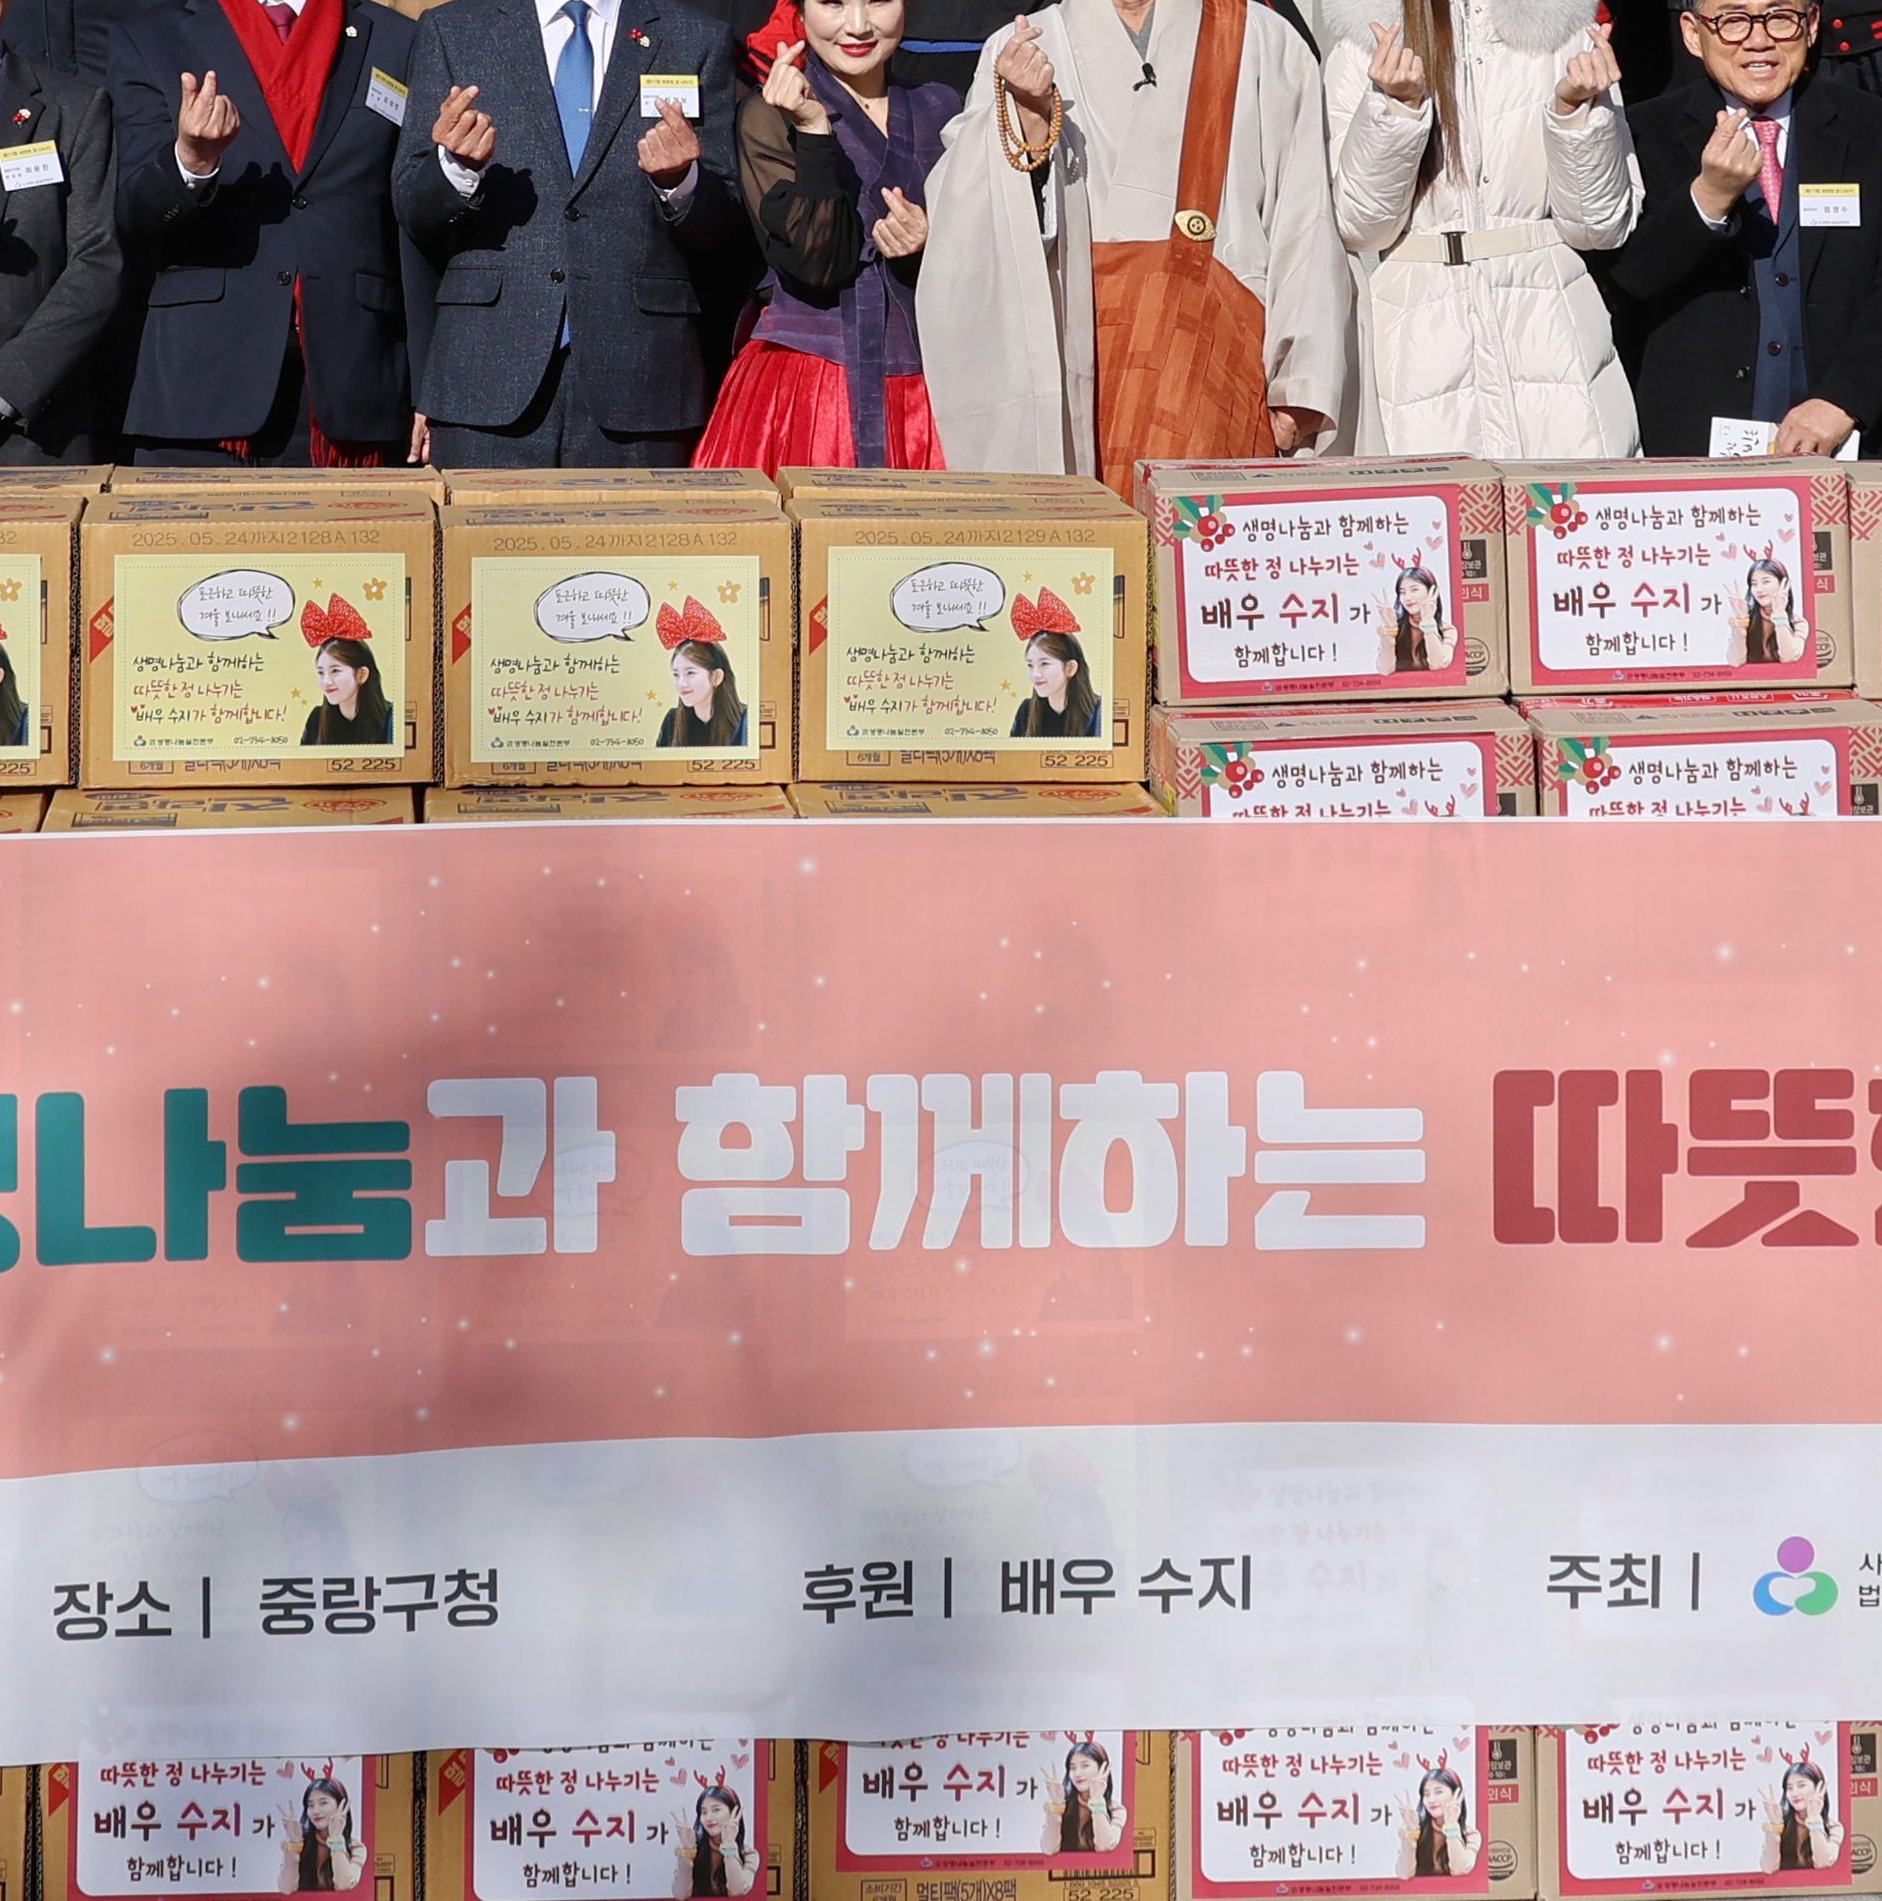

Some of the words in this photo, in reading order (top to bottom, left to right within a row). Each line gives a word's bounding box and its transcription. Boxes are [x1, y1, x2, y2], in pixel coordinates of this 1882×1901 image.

[1596, 505, 1683, 530] 생명나눔과
[1691, 504, 1761, 528] 함께하는
[1557, 546, 1611, 569] 따뜻한
[1617, 544, 1633, 569] 정
[1642, 543, 1711, 566] 나누기는
[1553, 581, 1616, 619] 배우
[1631, 582, 1689, 618] 수지
[846, 645, 915, 664] 생명나눔과
[919, 644, 975, 664] 함께하는
[847, 670, 890, 690] 따뜻한
[893, 673, 906, 689] 정
[910, 671, 953, 690] 나누기는
[849, 700, 876, 714] 배우
[921, 695, 997, 715] 함께합니다!
[1044, 754, 1069, 768] 52
[1074, 754, 1109, 768] 225
[675, 1069, 1427, 1256] 함께하는
[802, 1559, 914, 1625] 후원
[1000, 1558, 1116, 1616] 배우
[1138, 1554, 1251, 1615] 수지
[1546, 1552, 1661, 1610] 주최
[53, 1580, 173, 1641] 장소
[259, 1568, 499, 1636] 중랑구청
[101, 1762, 159, 1787] 따뜻한
[164, 1760, 183, 1788] 정
[191, 1760, 266, 1785] 나누기는
[1488, 1760, 1512, 1771] 장보관
[1588, 1751, 1643, 1775] 따뜻한
[1649, 1749, 1666, 1775] 정
[1675, 1747, 1746, 1771] 나누기는
[1583, 1787, 1647, 1826] 배우
[1663, 1788, 1723, 1824] 수지
[94, 1800, 162, 1842] 배우
[177, 1802, 240, 1841] 수지
[1488, 1853, 1513, 1863] ACCP
